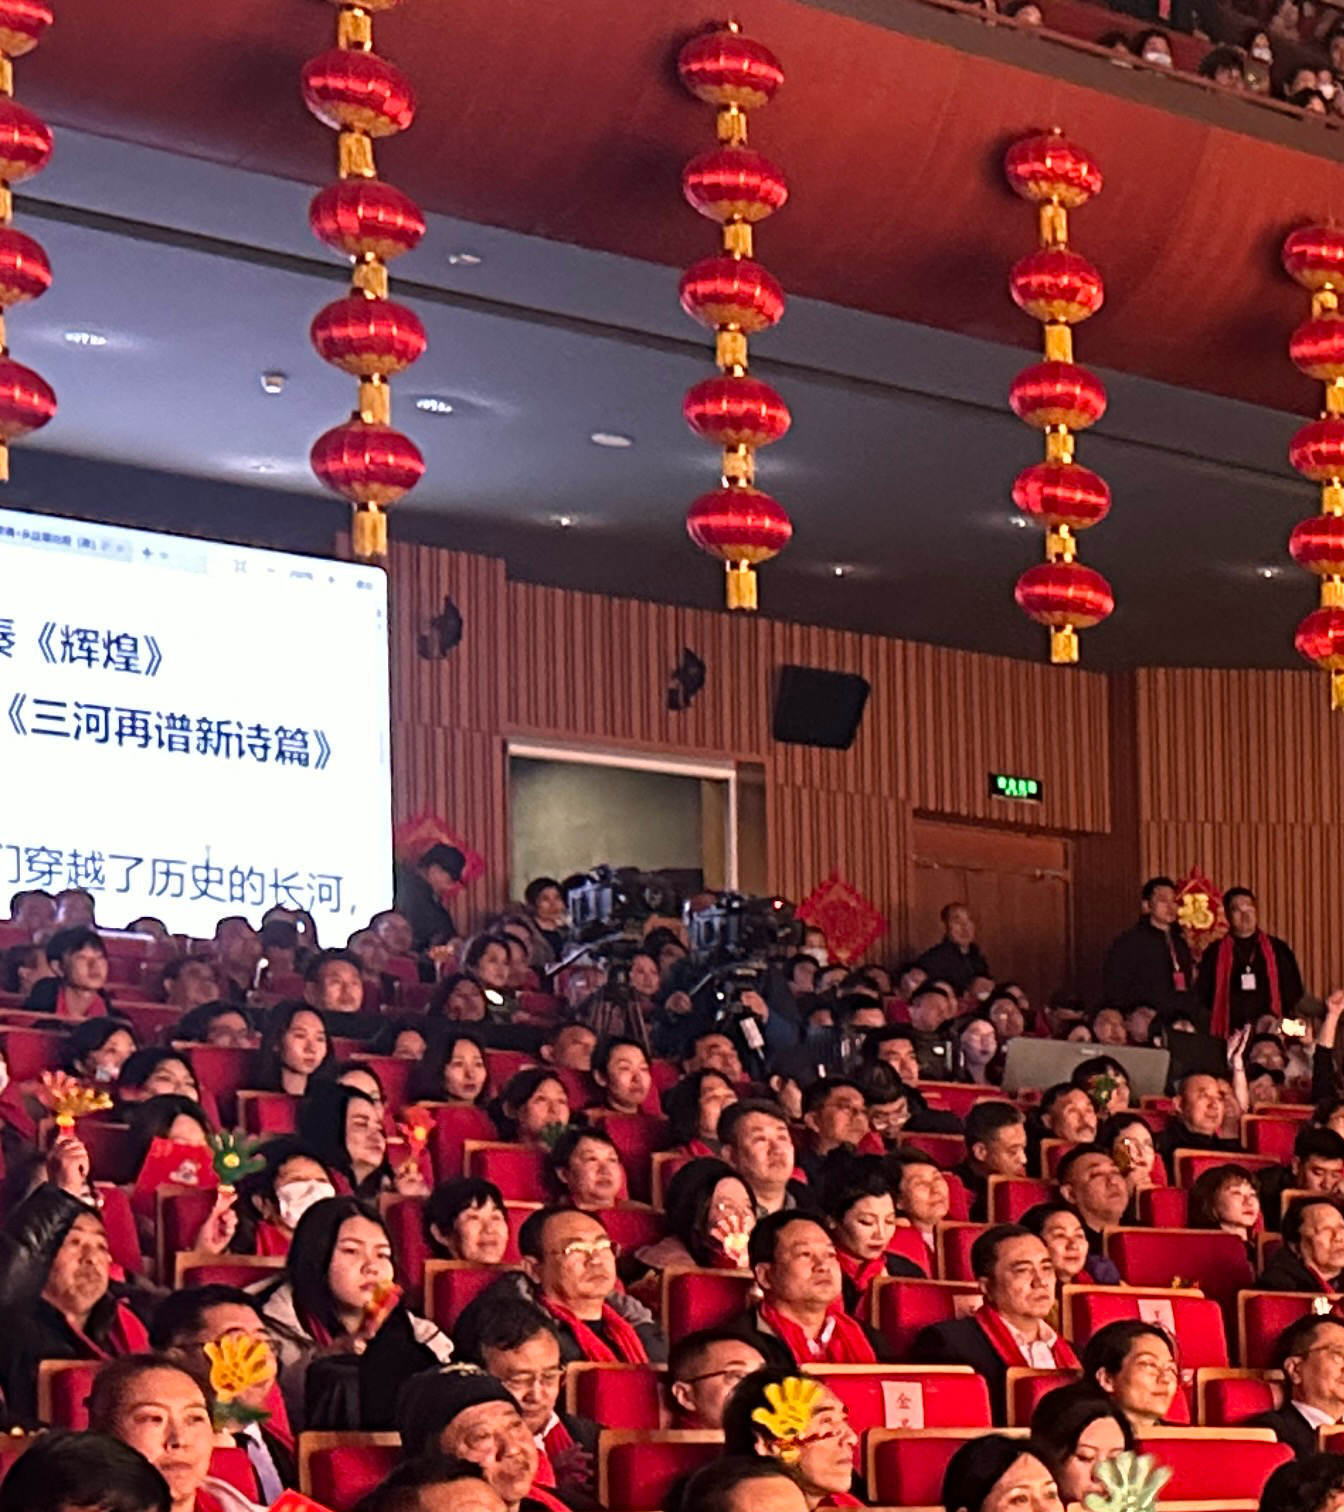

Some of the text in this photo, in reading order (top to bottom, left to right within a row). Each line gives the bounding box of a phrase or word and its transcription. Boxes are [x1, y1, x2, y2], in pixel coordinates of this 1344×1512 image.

[8, 692, 332, 771] 《三河再谱新诗篇》
